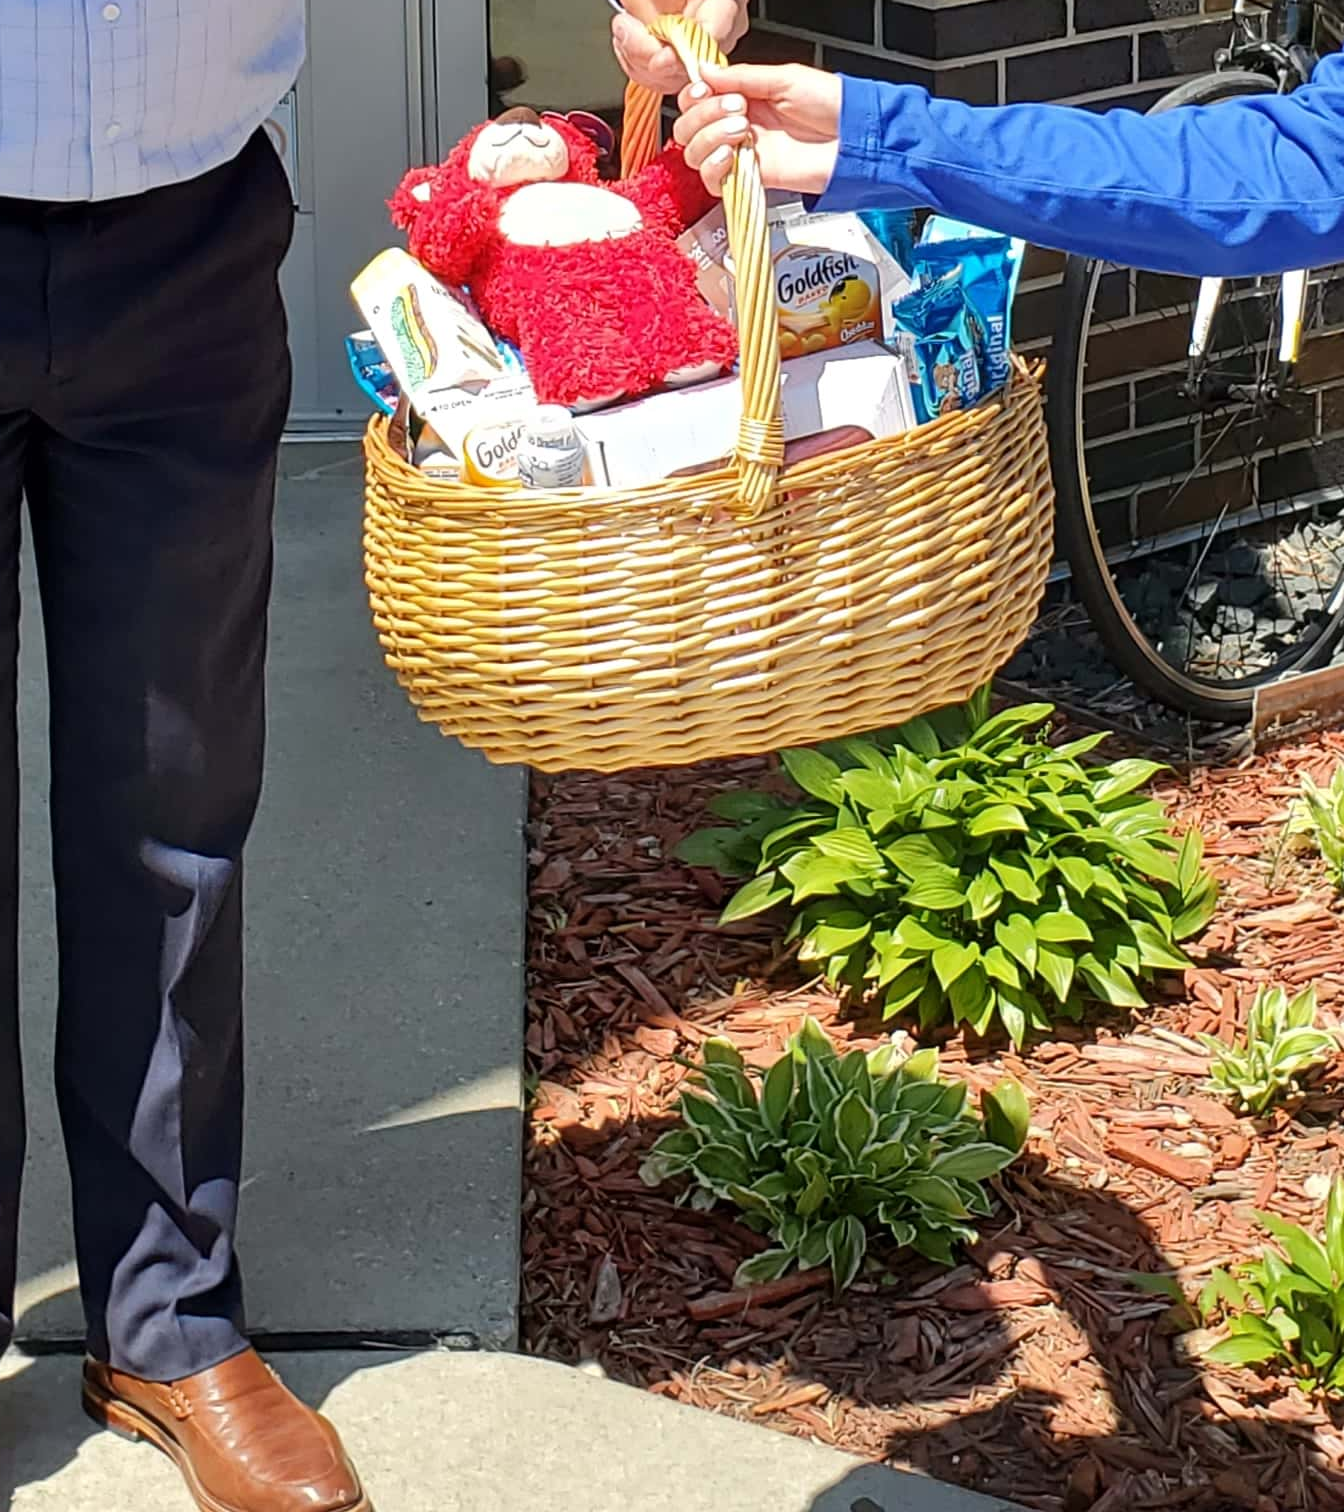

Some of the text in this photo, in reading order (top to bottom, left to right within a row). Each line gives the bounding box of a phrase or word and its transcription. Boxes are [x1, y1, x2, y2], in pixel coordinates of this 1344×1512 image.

[777, 253, 857, 304] Goldfish
[959, 349, 981, 406] ginal
[476, 424, 527, 469] Gold
